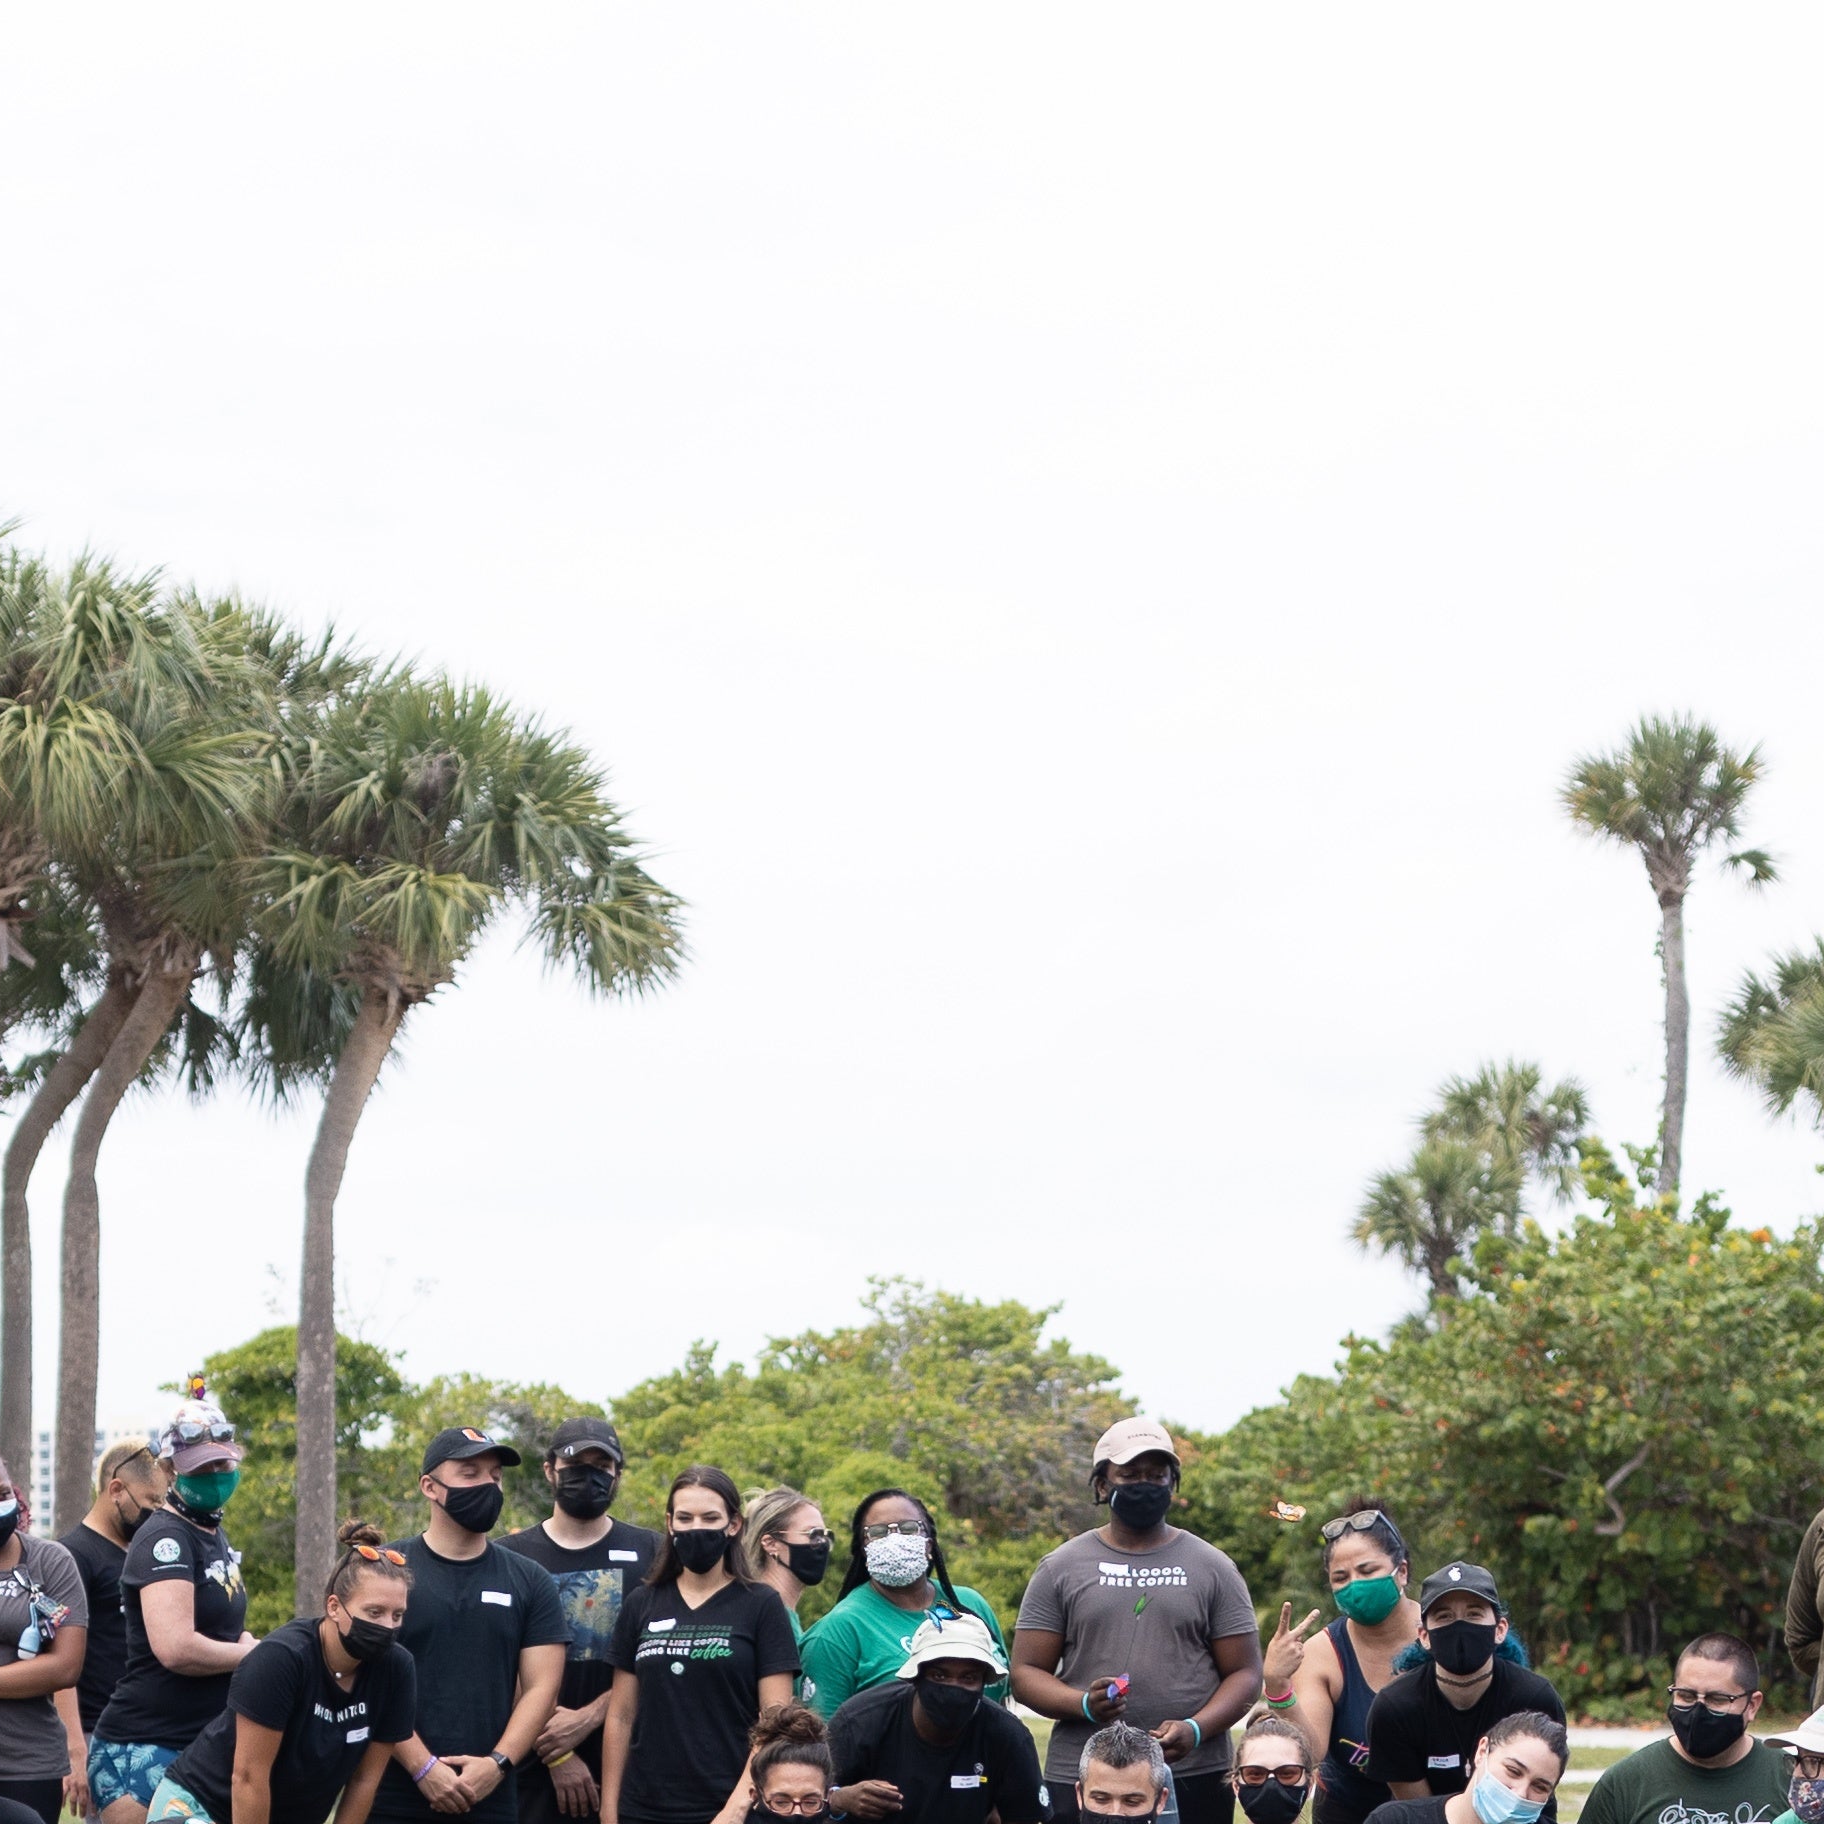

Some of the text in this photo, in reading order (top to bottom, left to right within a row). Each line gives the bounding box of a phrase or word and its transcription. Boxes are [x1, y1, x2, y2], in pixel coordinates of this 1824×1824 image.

[1099, 1575, 1188, 1588] FREE COFFEE
[668, 1639, 692, 1647] LIKE
[692, 1637, 730, 1647] COFFEE
[666, 1647, 690, 1656] LIKE
[690, 1641, 734, 1660] coffee
